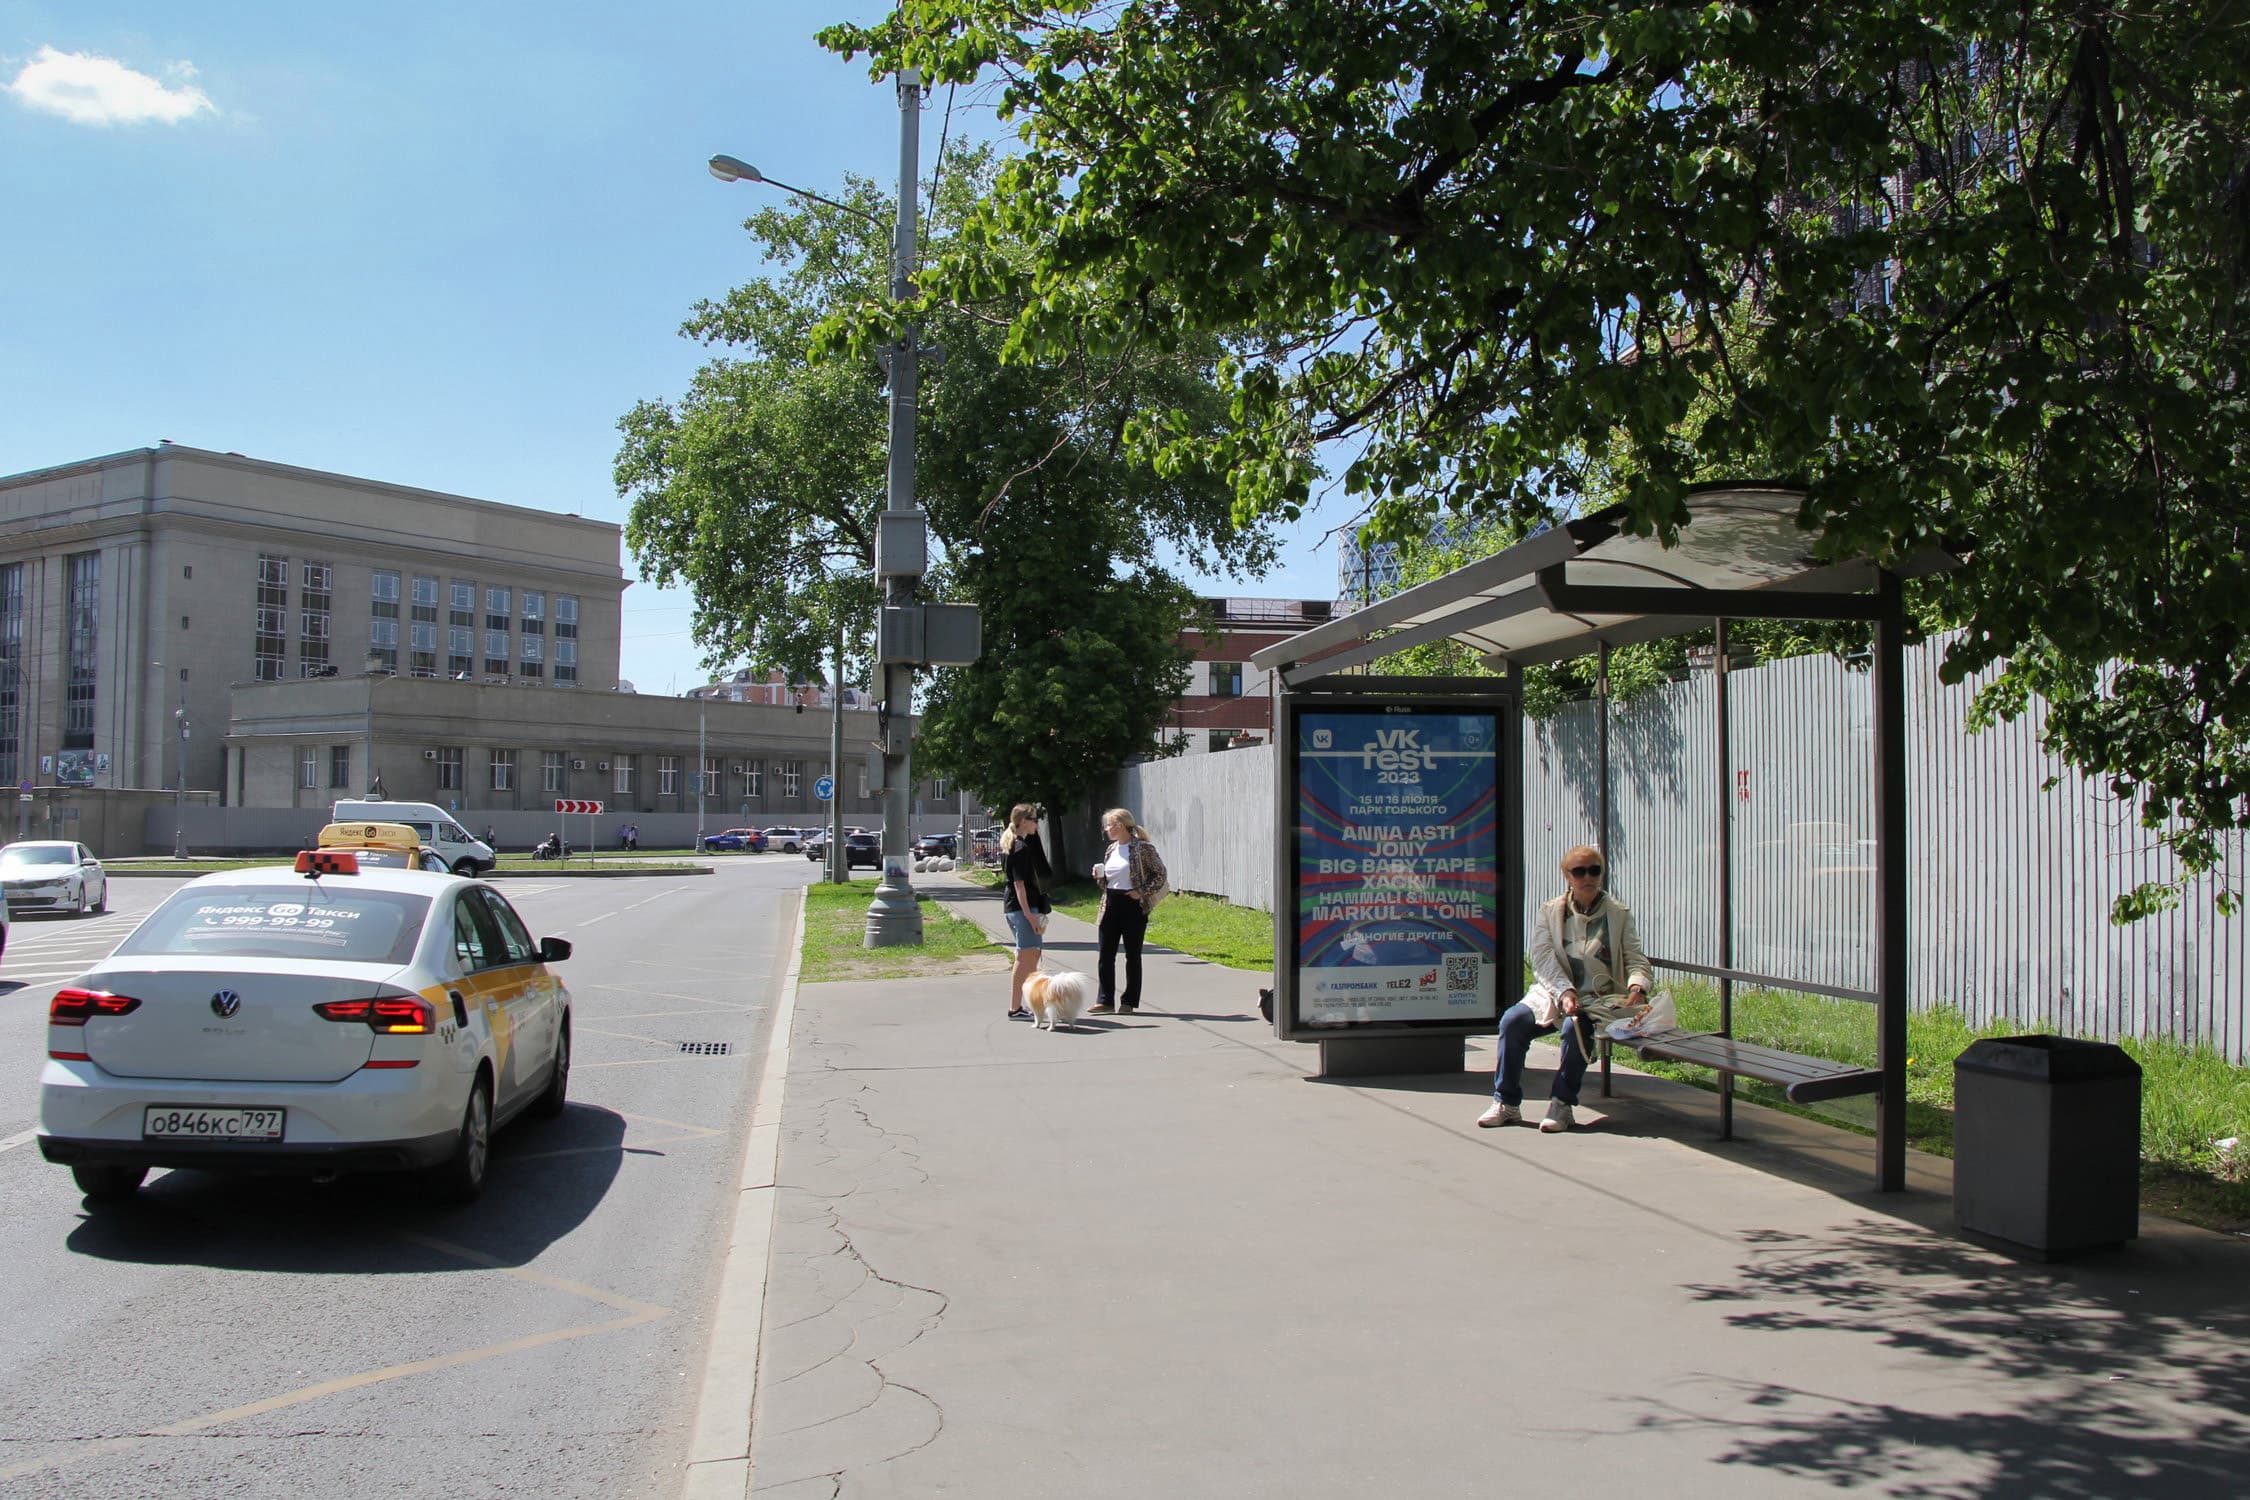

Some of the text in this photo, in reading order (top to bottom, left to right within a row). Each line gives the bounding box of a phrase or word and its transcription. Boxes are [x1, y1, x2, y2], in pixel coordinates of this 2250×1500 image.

[1376, 729, 1420, 749] VK
[1363, 743, 1437, 770] fest
[1377, 772, 1421, 784] 2023
[1360, 795, 1438, 804] 15 И 16 ИЮЛЯ
[1350, 806, 1447, 815] ПАРК ГОРЬКОГО
[1341, 825, 1455, 840] ANNA ASTI
[1369, 842, 1428, 857] JONY
[1319, 857, 1476, 874] BIG BABY TAPE
[1361, 875, 1436, 889] ХАСКИ
[1319, 891, 1401, 905] HAMMALI
[1406, 891, 1418, 904] &
[197, 905, 265, 915] Яндекс
[307, 906, 361, 919] Такси
[1312, 904, 1483, 921] MARKUL L'ONE
[222, 916, 334, 928] 999-99-99
[1407, 931, 1453, 943] ДРУГИЕ
[1331, 982, 1378, 990] ГАЗПРОМБАНК
[1386, 979, 1412, 989] TELE2
